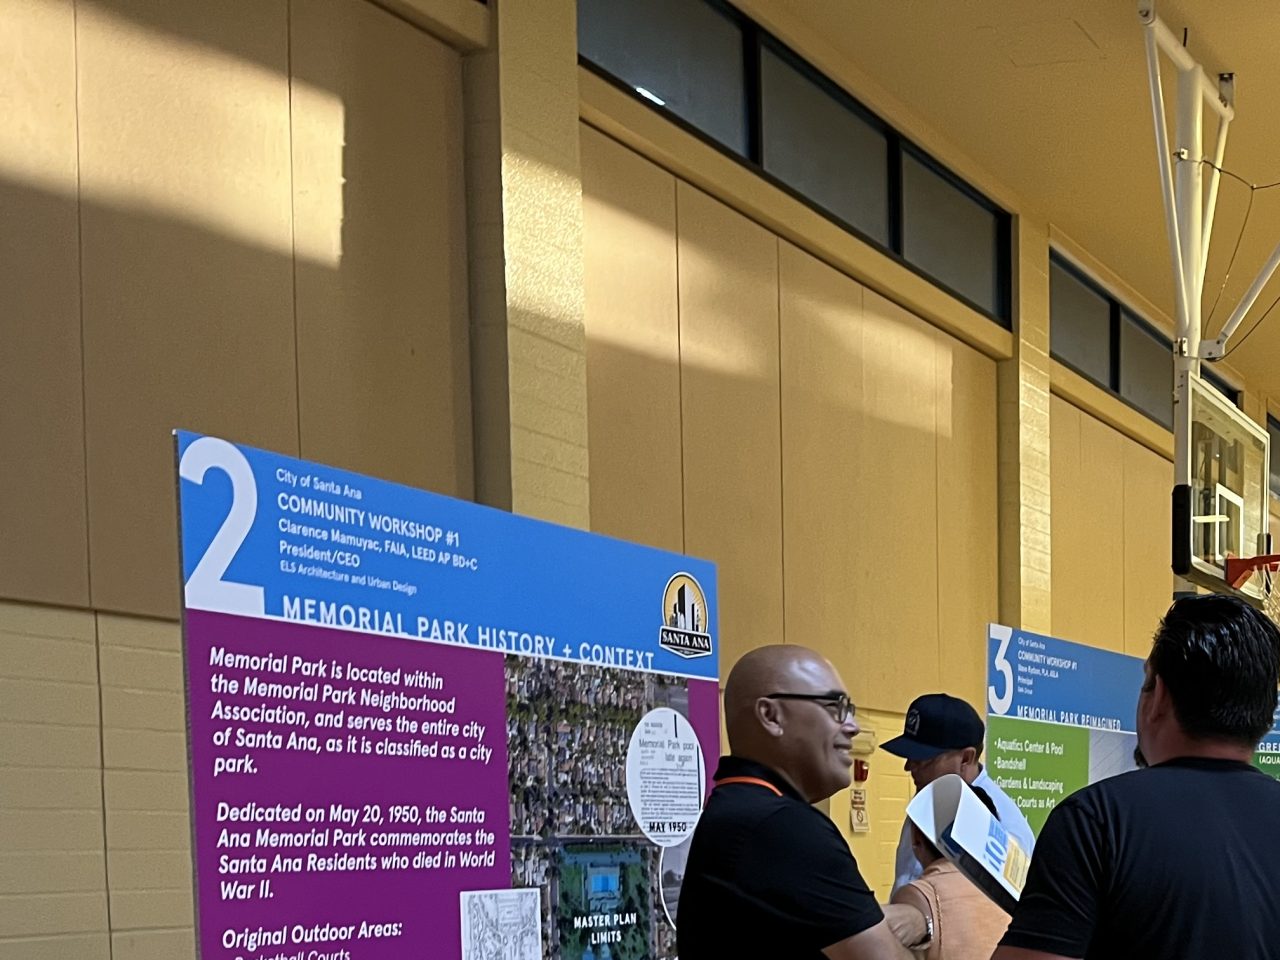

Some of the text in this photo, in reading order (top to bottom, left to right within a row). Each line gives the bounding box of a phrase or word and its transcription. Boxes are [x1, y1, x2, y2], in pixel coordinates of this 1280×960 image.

[276, 468, 362, 500] City of Santa Ana
[179, 437, 265, 614] 2
[278, 493, 459, 547] COMMUNITY WORKSHOP #1
[279, 518, 477, 570] Clarence Mamuyac, FAIA, LEED AP BD+C
[280, 540, 360, 568] President/CEO
[283, 595, 408, 636] MEMORIAL
[417, 616, 469, 643] PARK
[478, 626, 555, 656] HISTORY
[579, 643, 654, 670] CONTEXT
[662, 630, 710, 649] SANTA ANA
[210, 647, 443, 690] Memorial Park is located within
[988, 623, 1013, 715] 3
[1018, 650, 1046, 664] COMMUNITY
[1046, 655, 1071, 668] WORKSHOP
[211, 674, 455, 713] the Memorial Park Neighborhood
[211, 700, 485, 742] Association, and serves the entire city
[1017, 705, 1121, 730] MEMORIAL PARK REIMAGINED
[213, 727, 492, 764] of Santa Ana, as it is classified as a city
[997, 738, 1063, 755] Aquatics Center & Pool
[214, 754, 257, 776] park.
[997, 756, 1026, 770] Bandshell
[996, 776, 1063, 794] Gardens & Landscaping
[650, 822, 687, 833] MAY 1950
[574, 913, 637, 929] MASTER PLAN
[223, 921, 402, 952] Original Outdoor Areas:
[591, 931, 622, 945] LIMITS
